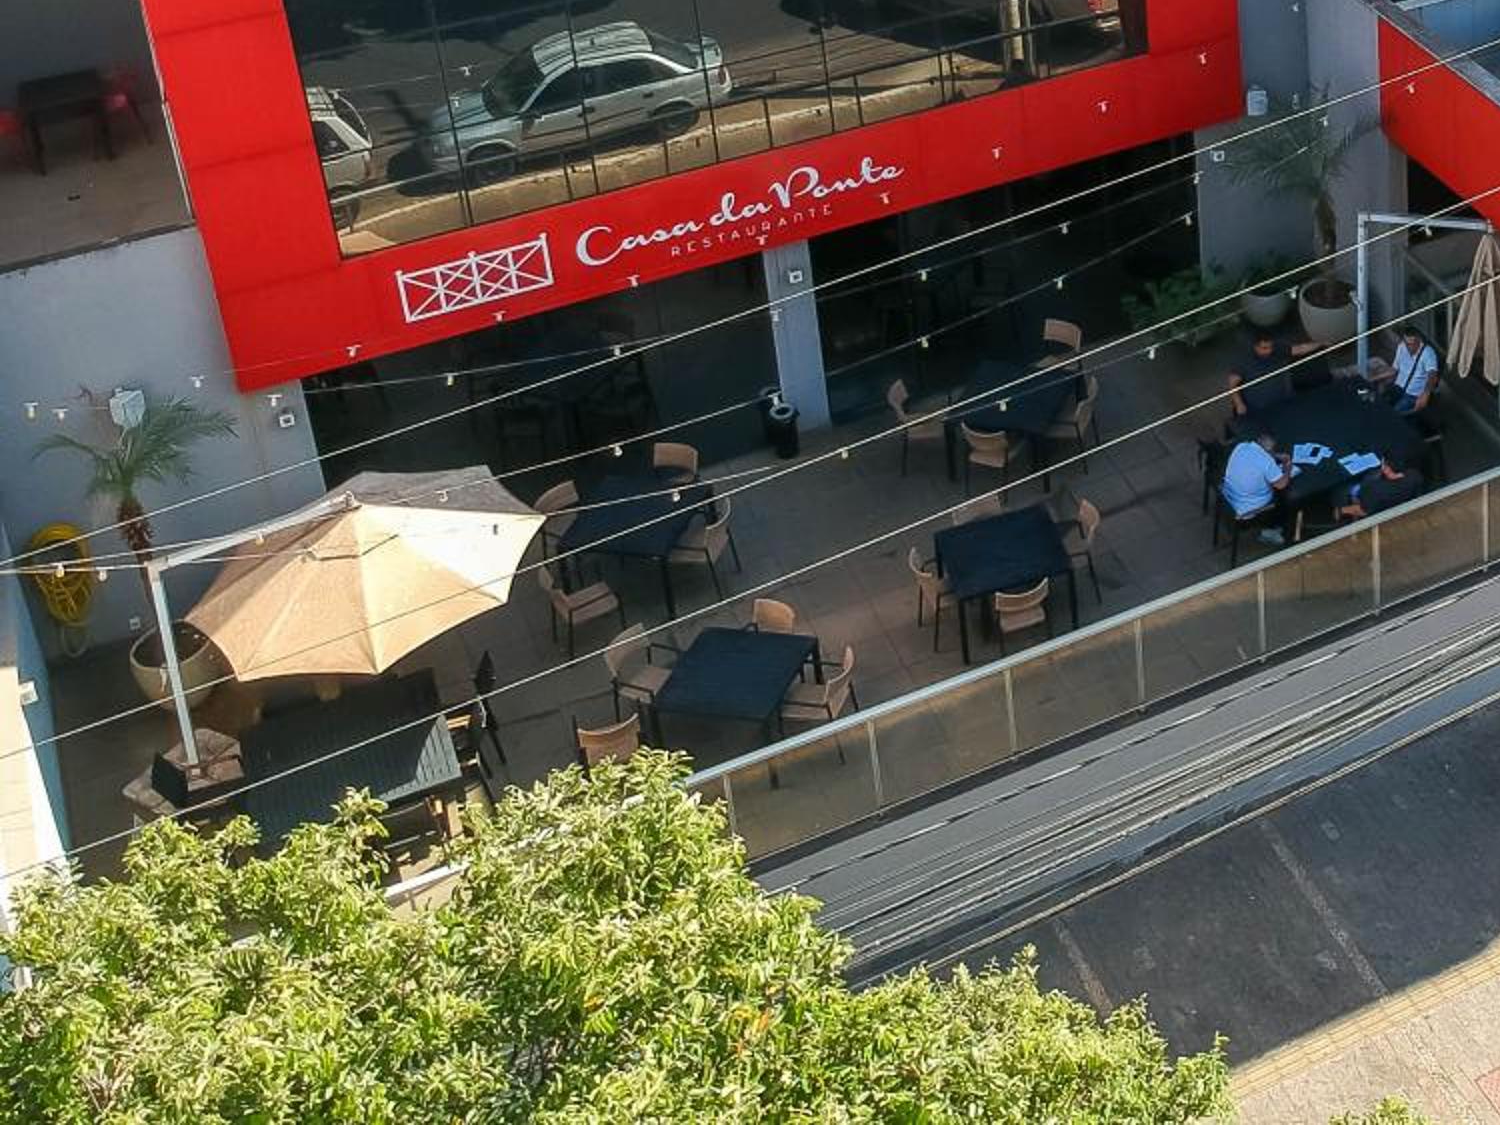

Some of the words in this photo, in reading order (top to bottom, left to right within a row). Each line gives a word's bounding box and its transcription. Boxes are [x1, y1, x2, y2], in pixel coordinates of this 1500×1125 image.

[575, 221, 704, 266] Casa
[709, 192, 771, 226] da
[769, 156, 905, 208] Ponte
[671, 204, 833, 256] RESTAURANTE
